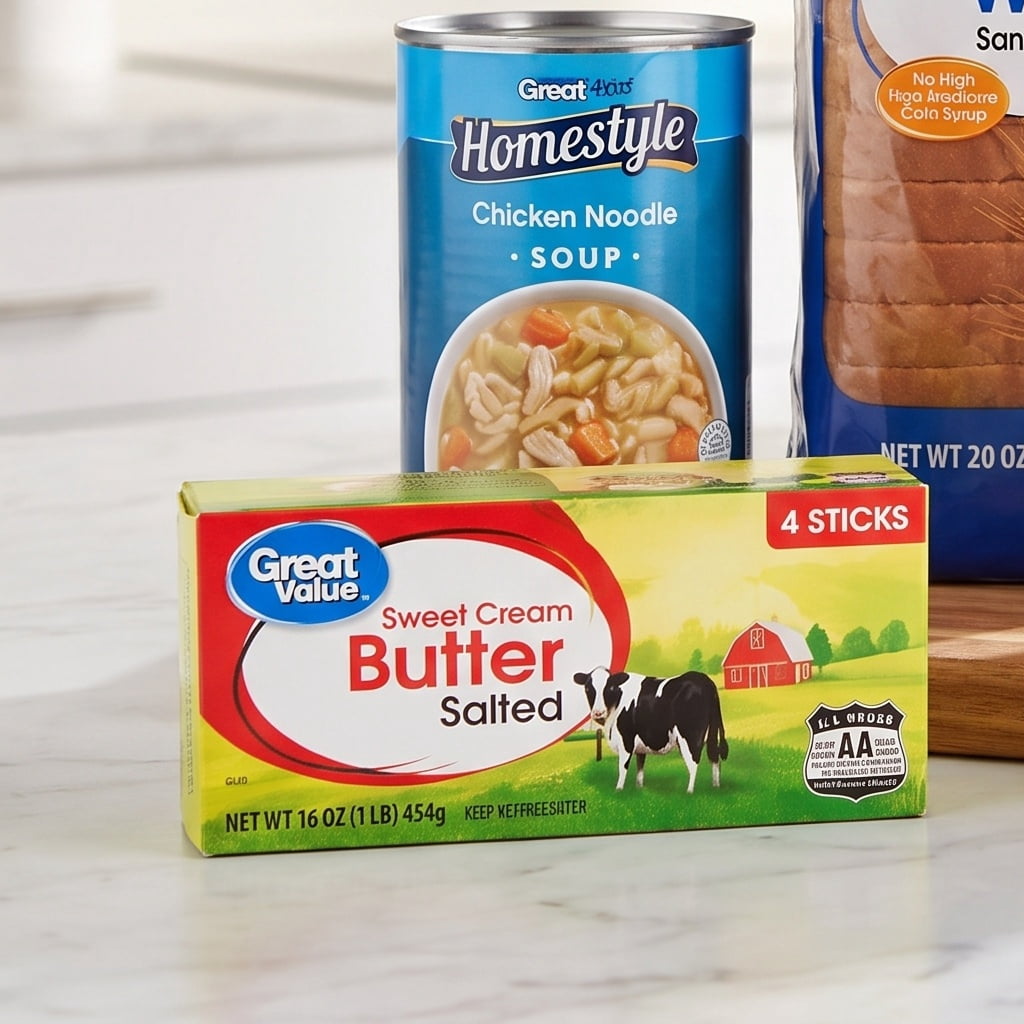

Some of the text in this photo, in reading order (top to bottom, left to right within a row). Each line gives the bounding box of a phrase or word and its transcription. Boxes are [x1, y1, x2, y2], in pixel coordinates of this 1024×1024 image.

[518, 78, 588, 101] Great
[913, 72, 975, 89] No High
[943, 106, 988, 123] Syrup
[461, 102, 685, 173] Homestyle
[472, 201, 678, 228] Chicken Noodle
[531, 246, 621, 269] SOUP
[881, 442, 922, 468] NET
[926, 444, 962, 468] WT
[967, 445, 994, 469] 20
[780, 505, 909, 534] 4 STICKS
[249, 547, 359, 582] Great
[275, 579, 359, 604] Value
[382, 602, 573, 630] Sweet Cream
[349, 629, 564, 693] Butter
[440, 690, 563, 727] Salted
[838, 731, 874, 759] AA
[226, 802, 446, 833] NET WT 16 OZ (1 LB) 454g
[465, 805, 494, 820] KEEP
